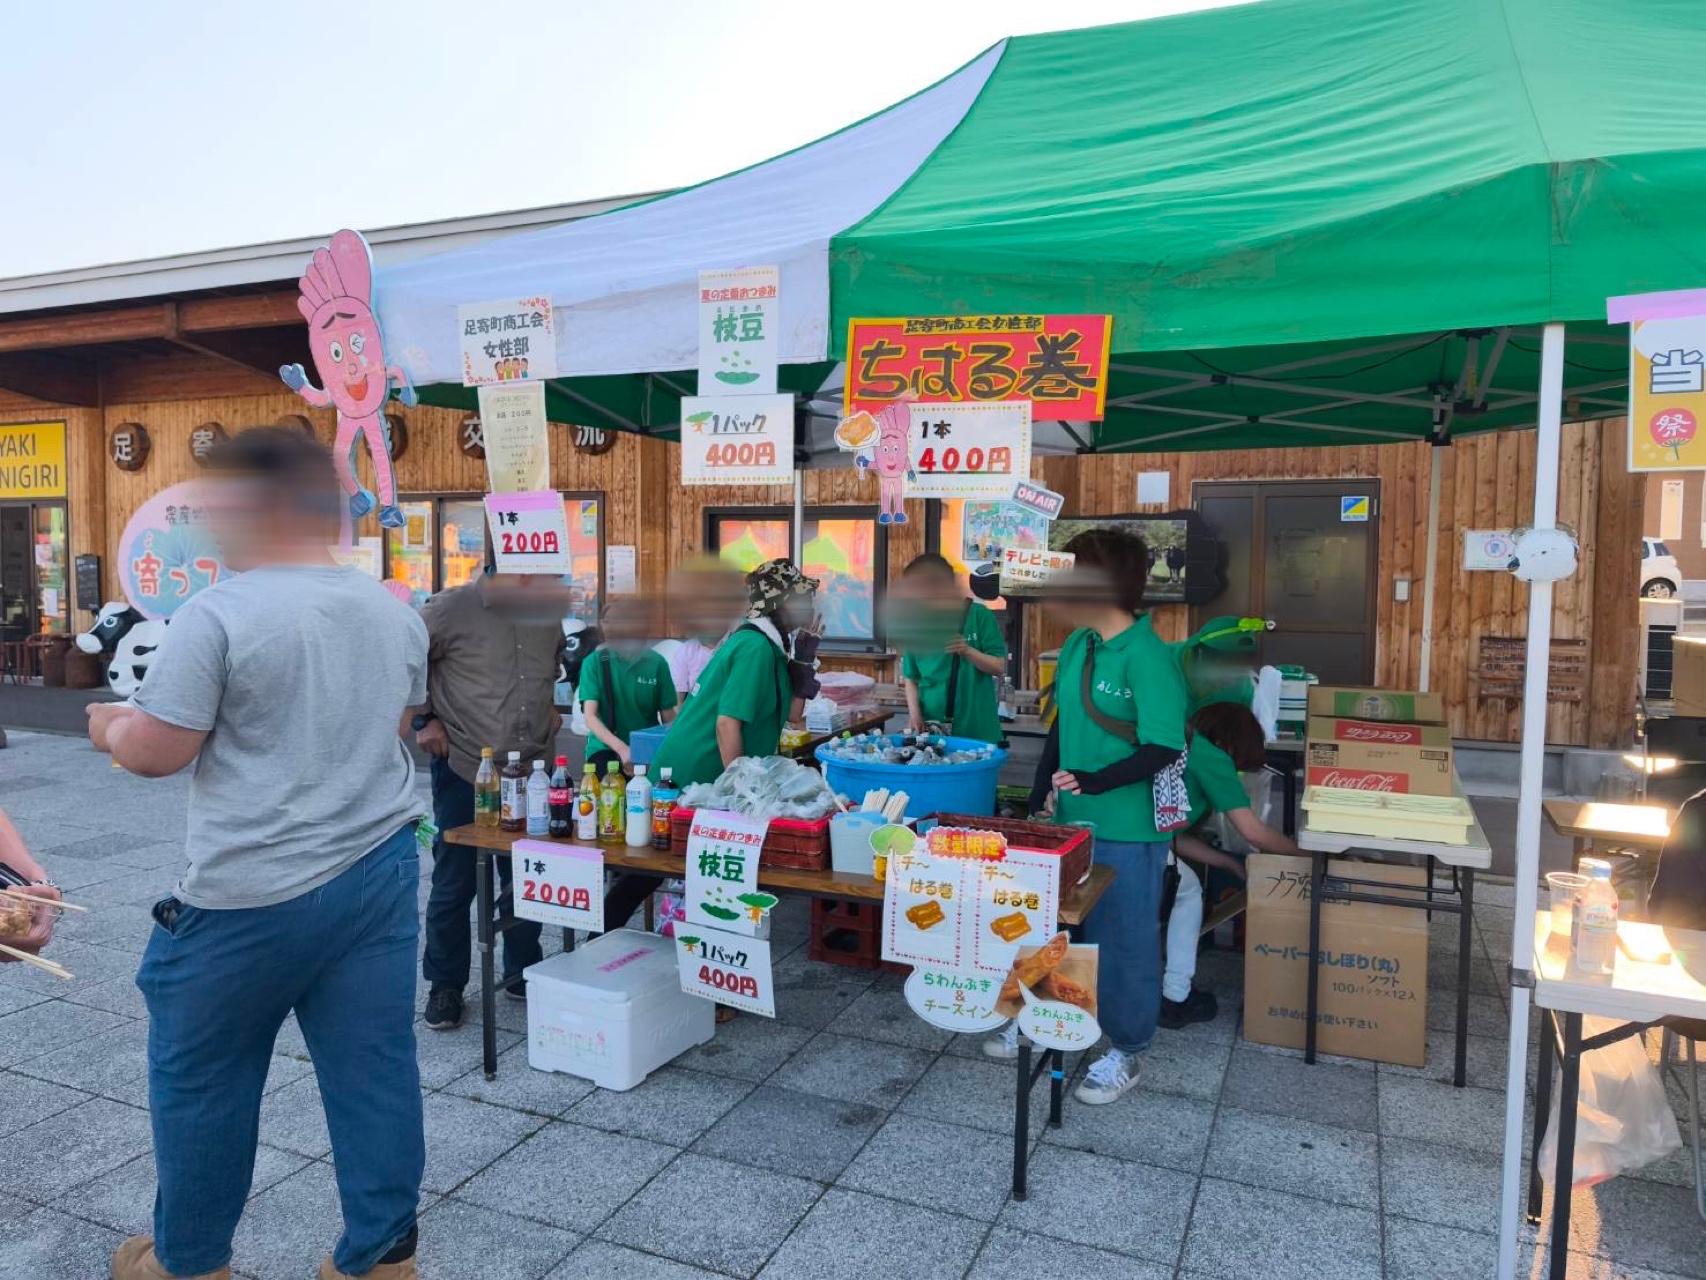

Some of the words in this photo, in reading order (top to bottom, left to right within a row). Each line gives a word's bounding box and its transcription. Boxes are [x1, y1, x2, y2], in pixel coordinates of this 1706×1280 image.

[464, 312, 544, 335] 足寄町商工会
[713, 312, 765, 343] 枝豆
[483, 337, 529, 358] 女性部
[857, 331, 1098, 400] ちはる巻
[712, 414, 767, 433] 1パック
[921, 420, 951, 439] 1本
[1656, 413, 1692, 437] 祭
[113, 433, 132, 462] 足
[706, 442, 776, 466] 400円
[919, 447, 1011, 472] 400円
[1017, 486, 1035, 504] ON
[1035, 493, 1058, 512] AIR
[498, 511, 519, 526] 1本
[502, 530, 559, 552] 200円
[1006, 550, 1073, 570] テレビで紹介
[524, 858, 546, 875] 1本
[699, 850, 745, 883] 枝豆
[523, 880, 590, 910] 200円
[909, 878, 953, 899] はる巻
[993, 887, 1040, 910] はる巻
[700, 941, 747, 967] 1パック
[699, 965, 758, 998] 400円
[1368, 974, 1399, 988] ソフト
[955, 989, 965, 1002] &
